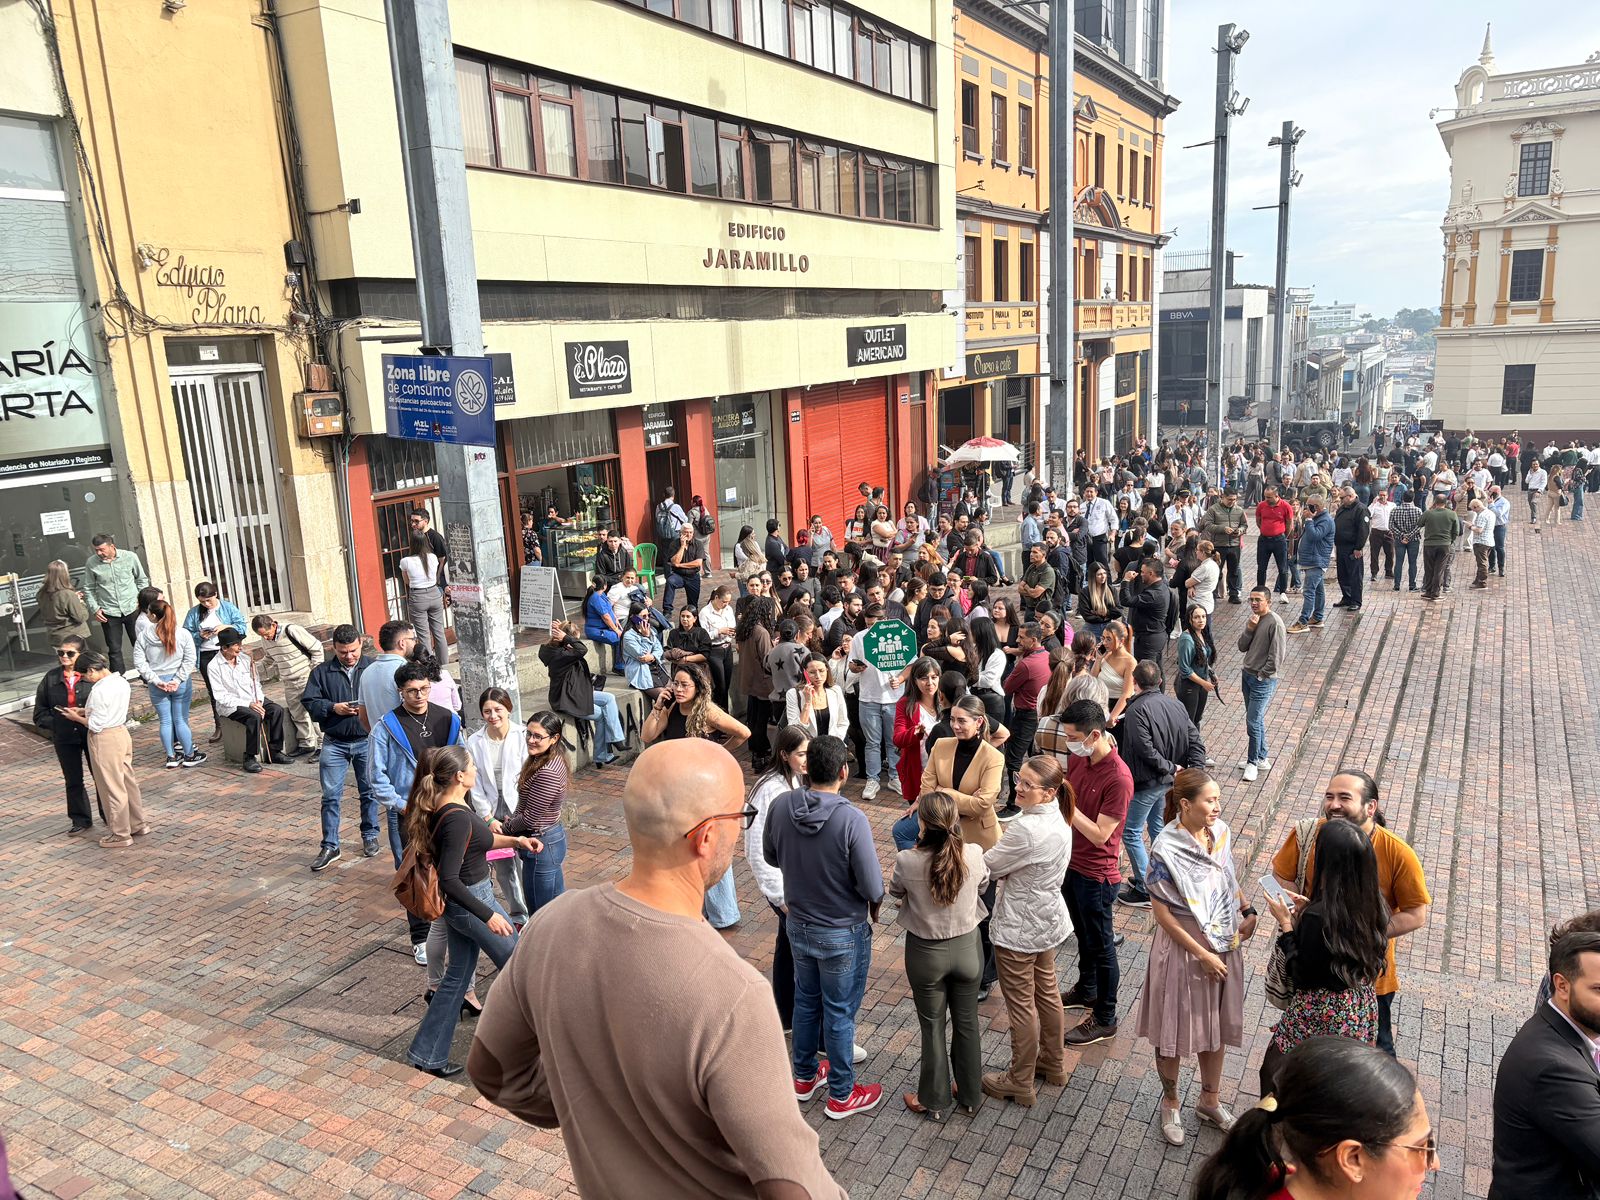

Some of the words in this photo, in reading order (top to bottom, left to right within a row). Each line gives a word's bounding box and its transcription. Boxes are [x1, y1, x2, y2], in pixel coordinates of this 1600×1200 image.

[728, 222, 786, 241] EDIFICIO
[703, 248, 810, 273] JARAMILLO
[1170, 311, 1194, 319] BBVA
[864, 327, 896, 344] OUTLET
[856, 344, 904, 363] AMERICANO
[584, 345, 625, 380] Plaza
[974, 354, 995, 375] Queso
[1000, 355, 1011, 372] café
[387, 364, 415, 380] Zona
[419, 364, 451, 382] libre
[388, 380, 399, 393] de
[402, 384, 452, 397] consumo
[0, 390, 93, 421] RTA
[420, 398, 452, 407] psicoactivas
[644, 420, 673, 430] JARAMILLO
[29, 461, 38, 469] de
[40, 458, 69, 466] Notariado
[76, 455, 101, 464] Registro
[877, 660, 906, 668] ENCUENTRO
[878, 653, 896, 661] PUNTO
[897, 652, 904, 660] DE
